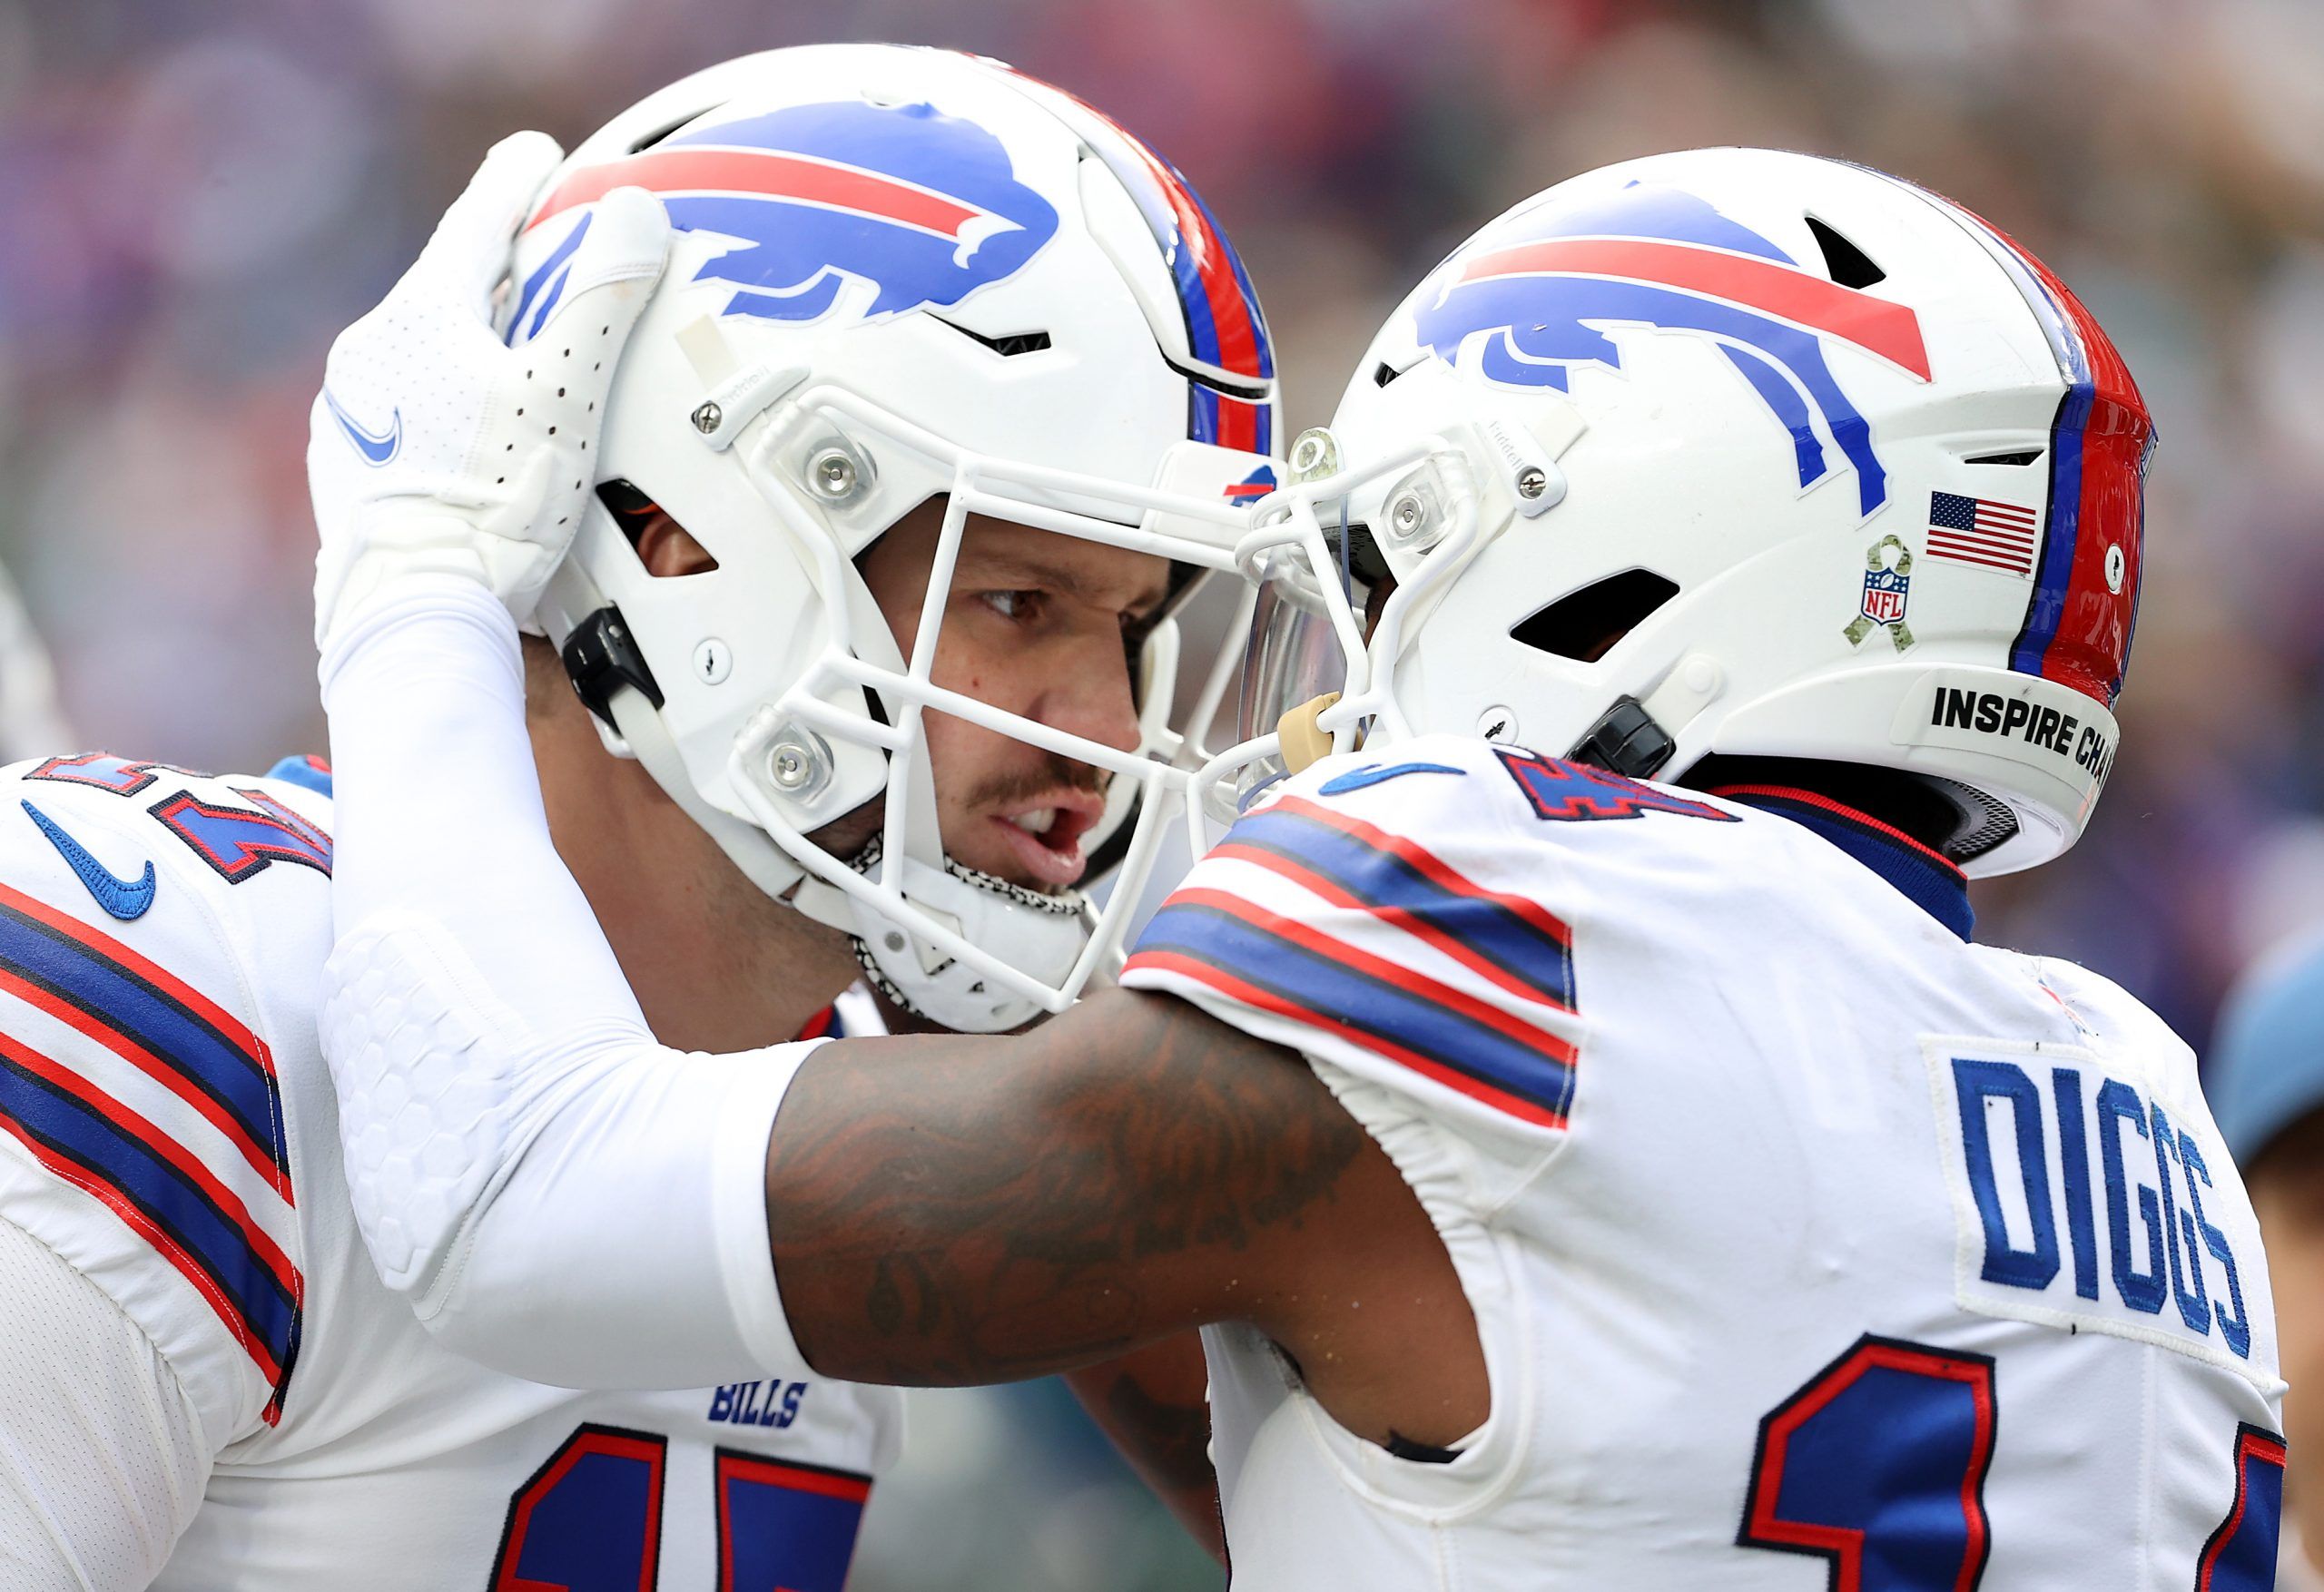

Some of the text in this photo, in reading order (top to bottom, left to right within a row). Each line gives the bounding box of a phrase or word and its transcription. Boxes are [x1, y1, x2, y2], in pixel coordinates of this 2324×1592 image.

[1866, 590, 1901, 619] NFL
[1931, 687, 2079, 756] INSPIRE
[1951, 1057, 2250, 1360] DIGGS
[707, 1379, 808, 1428] BILLS
